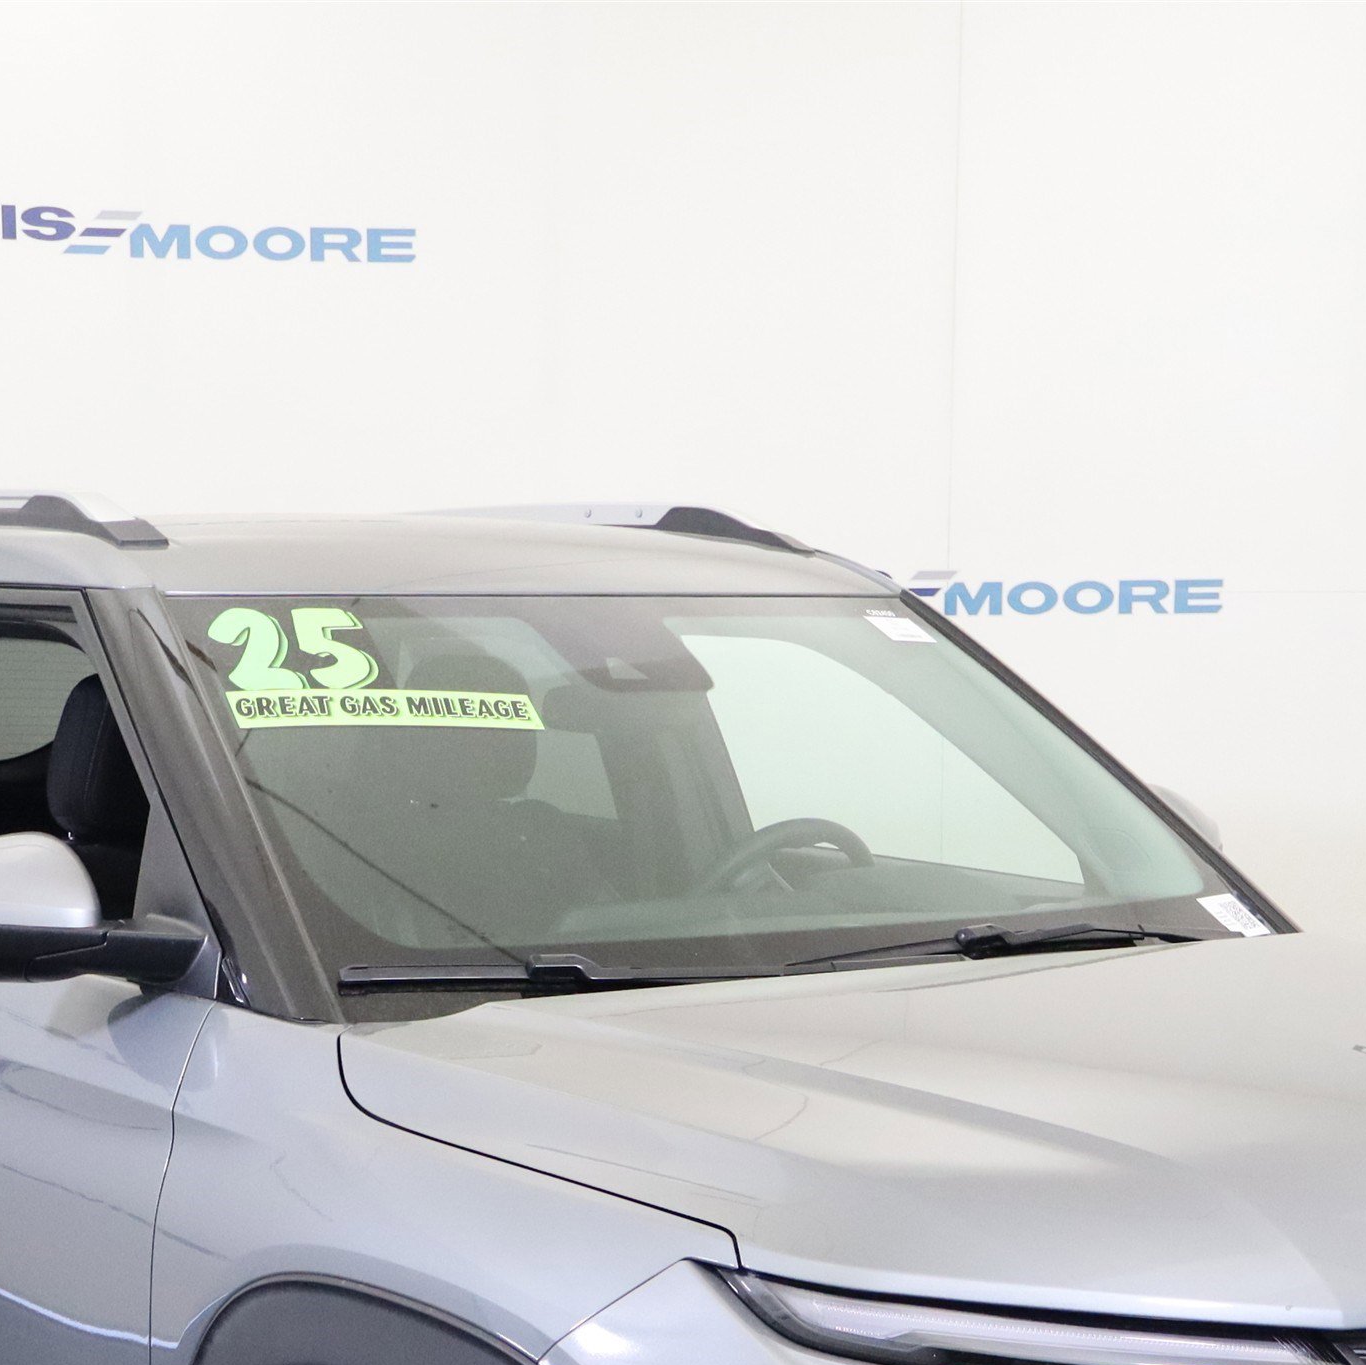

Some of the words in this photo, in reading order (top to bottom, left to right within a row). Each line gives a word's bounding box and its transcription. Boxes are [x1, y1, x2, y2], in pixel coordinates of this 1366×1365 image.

[129, 222, 416, 263] MOORE
[944, 579, 1224, 616] MOORE
[207, 607, 380, 690] 25
[235, 694, 334, 719] GREAT
[340, 694, 398, 716] GAS
[406, 695, 530, 721] MILEAGE
